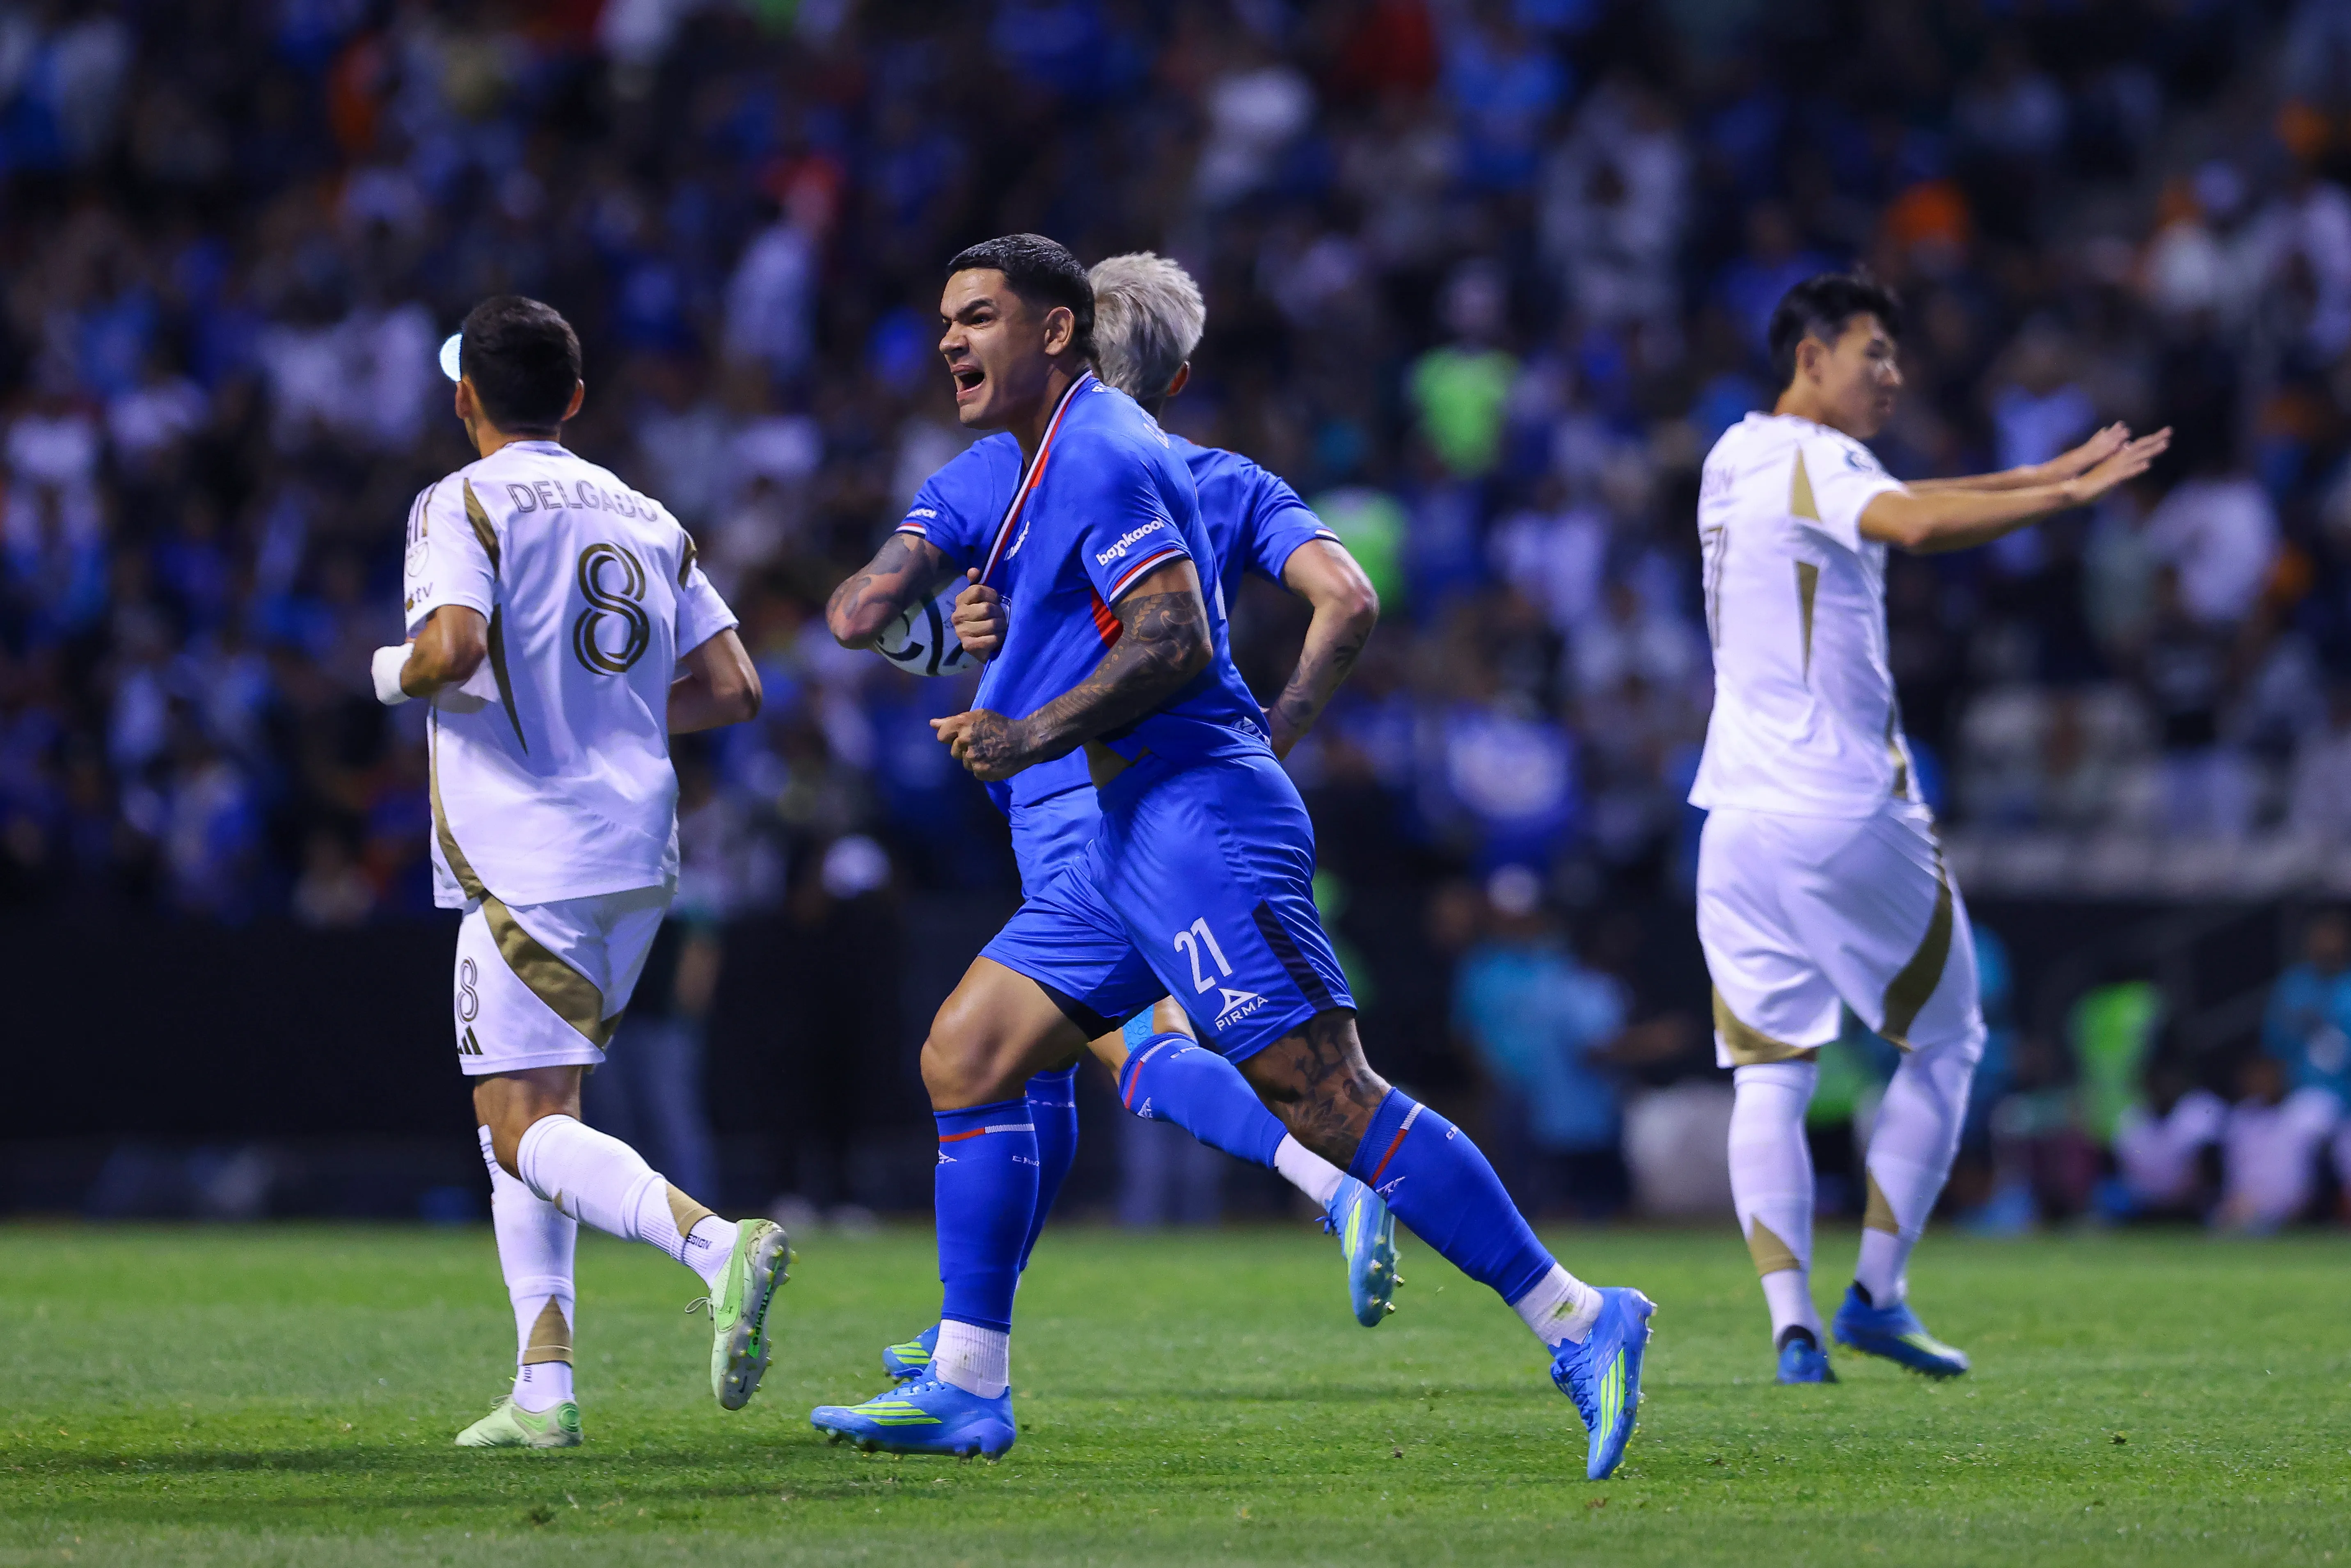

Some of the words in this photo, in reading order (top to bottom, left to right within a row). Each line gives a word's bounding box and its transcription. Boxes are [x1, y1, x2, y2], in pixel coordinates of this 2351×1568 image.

[506, 479, 658, 522] DELGADO
[574, 543, 650, 675] 8
[1173, 916, 1232, 994] 21
[457, 956, 479, 1025] 8
[1216, 996, 1269, 1032] PIRMA
[686, 1233, 713, 1250] ESIGN
